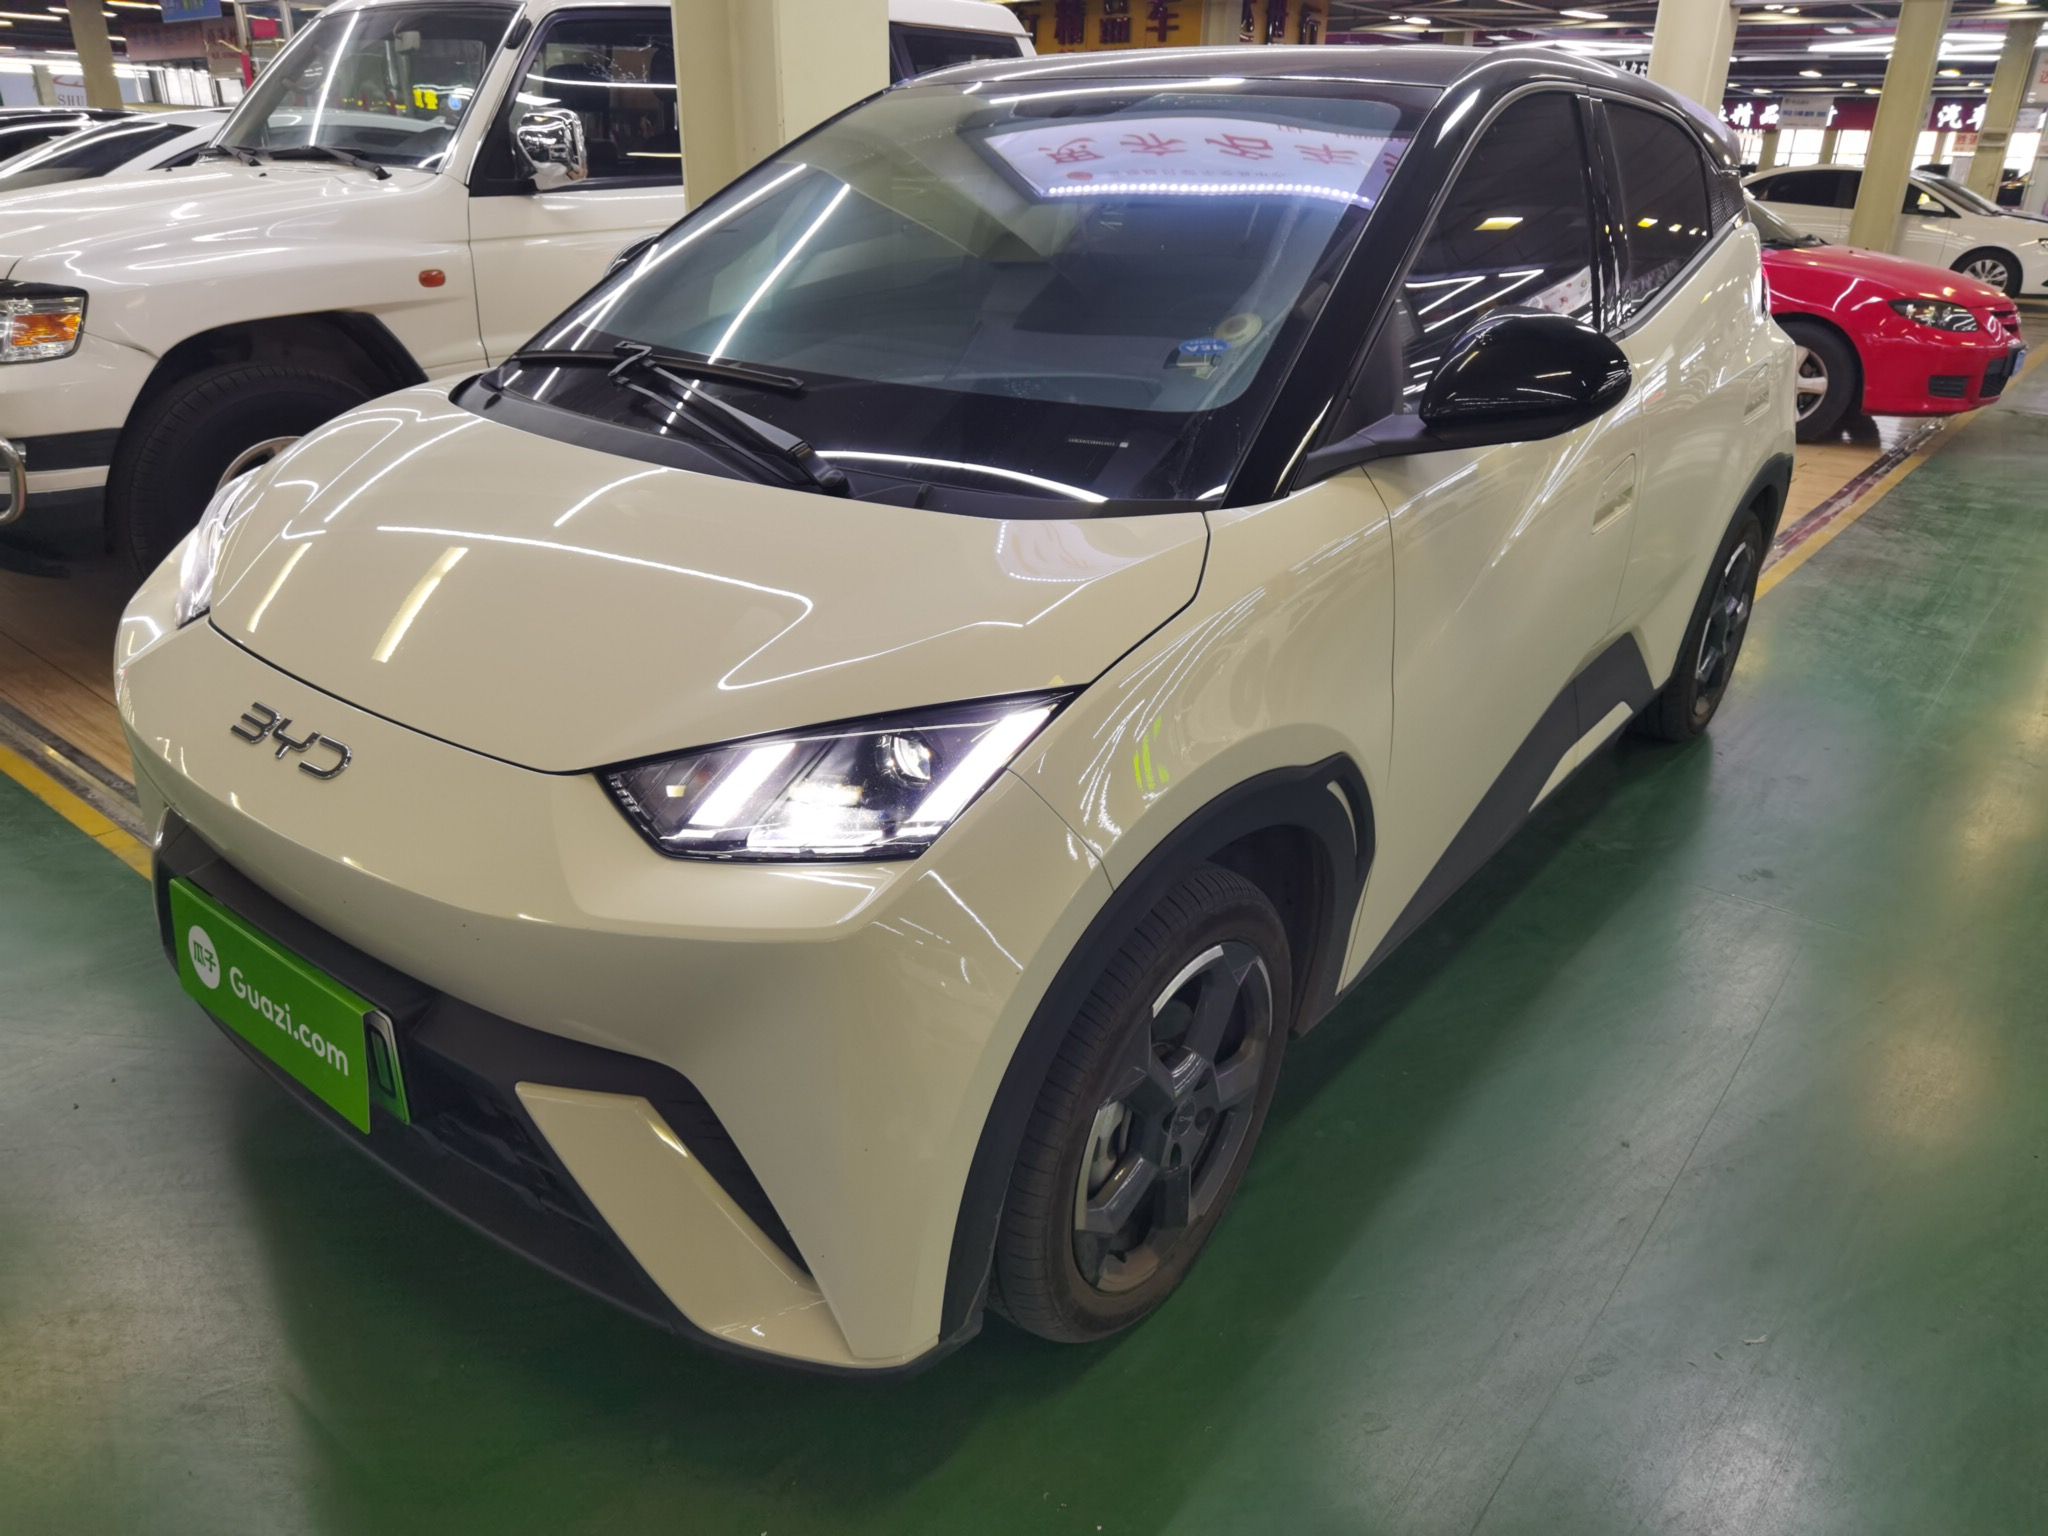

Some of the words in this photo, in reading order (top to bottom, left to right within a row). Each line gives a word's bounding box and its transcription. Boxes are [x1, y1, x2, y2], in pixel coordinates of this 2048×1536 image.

[231, 702, 352, 780] BYD
[193, 940, 217, 973] 瓜子
[229, 966, 349, 1077] Guazi.com
